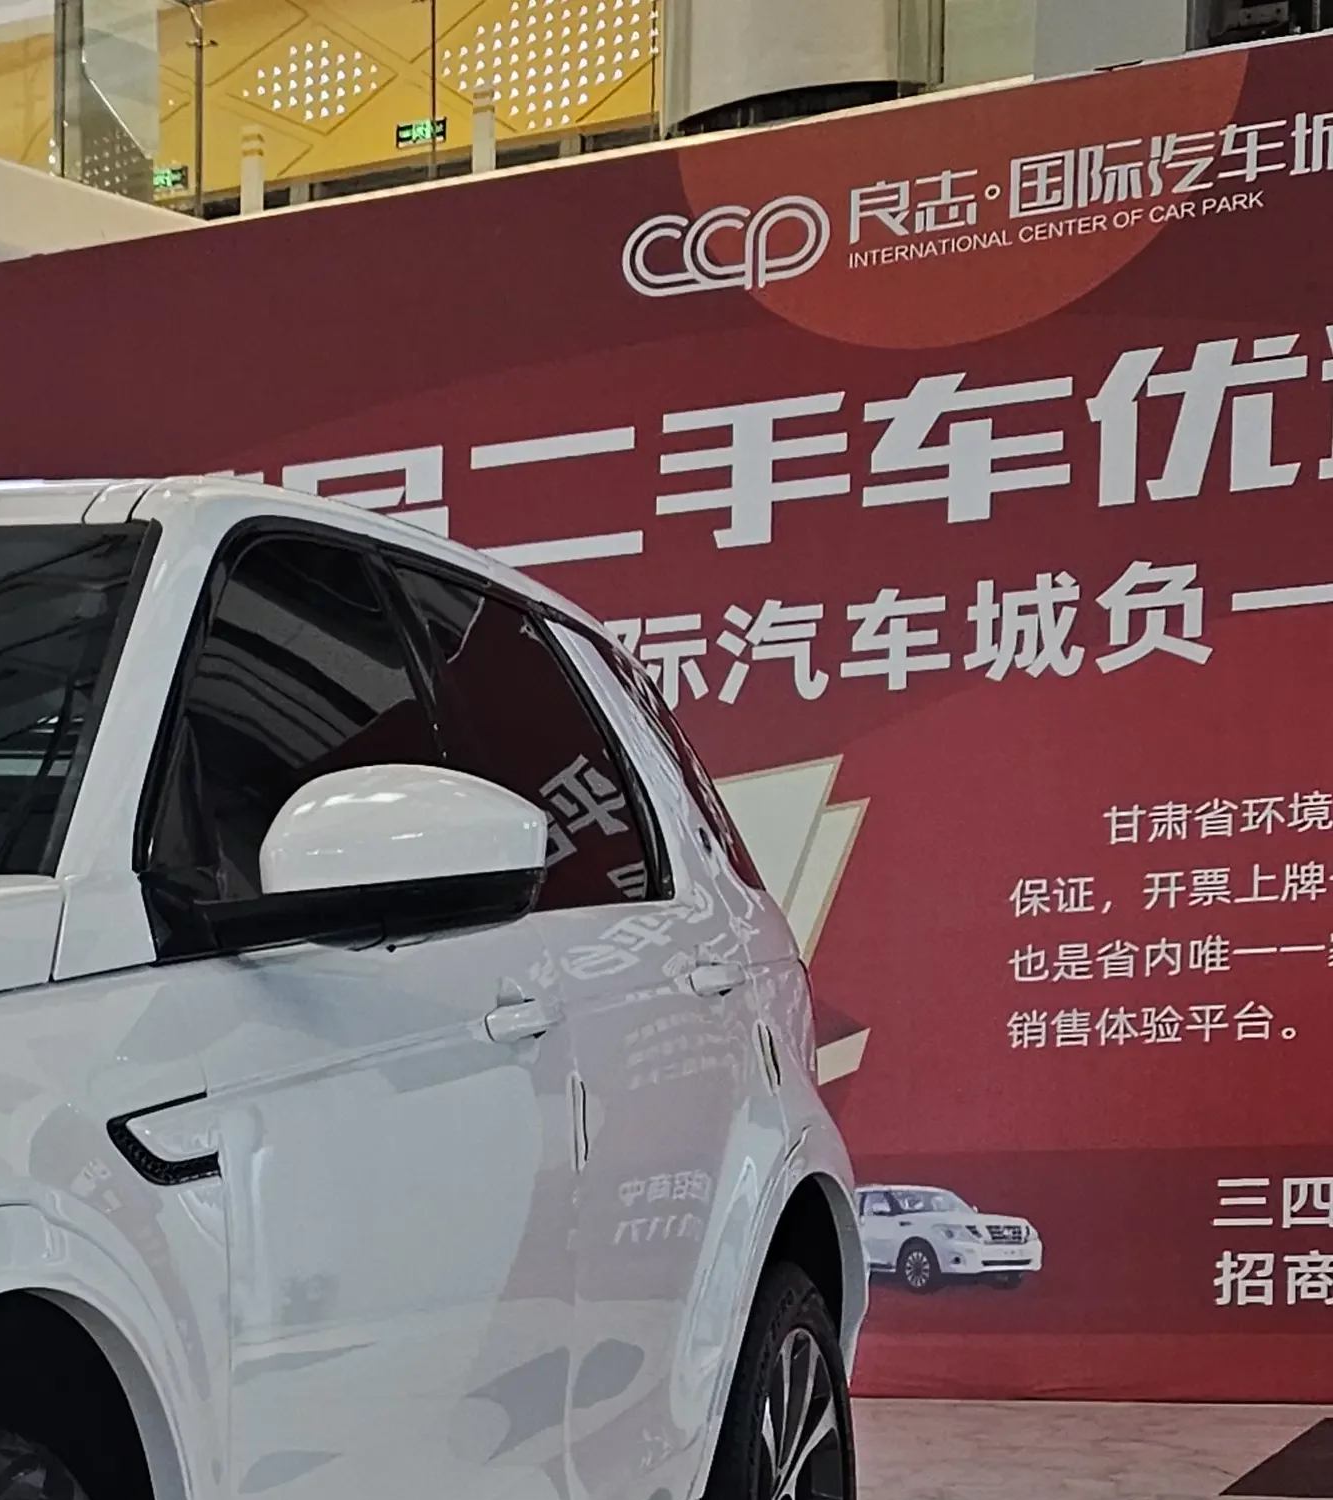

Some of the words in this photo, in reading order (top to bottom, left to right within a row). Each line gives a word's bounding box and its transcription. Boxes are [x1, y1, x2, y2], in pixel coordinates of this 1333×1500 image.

[847, 229, 1013, 269] INTERNATIONAL
[1018, 213, 1108, 244] CENTER
[1112, 208, 1144, 230] OF
[1149, 201, 1196, 223] CAR
[1202, 191, 1264, 215] PARK
[281, 325, 1333, 569] 二手车优
[1103, 789, 1333, 845] 甘肃省环境
[1009, 860, 1333, 918] 保证，开票上牌
[1007, 932, 1333, 983] 也是省内唯一一
[1006, 1000, 1297, 1049] 销售体验平台。
[1212, 1176, 1333, 1229] 三四
[1213, 1250, 1333, 1306] 招商
